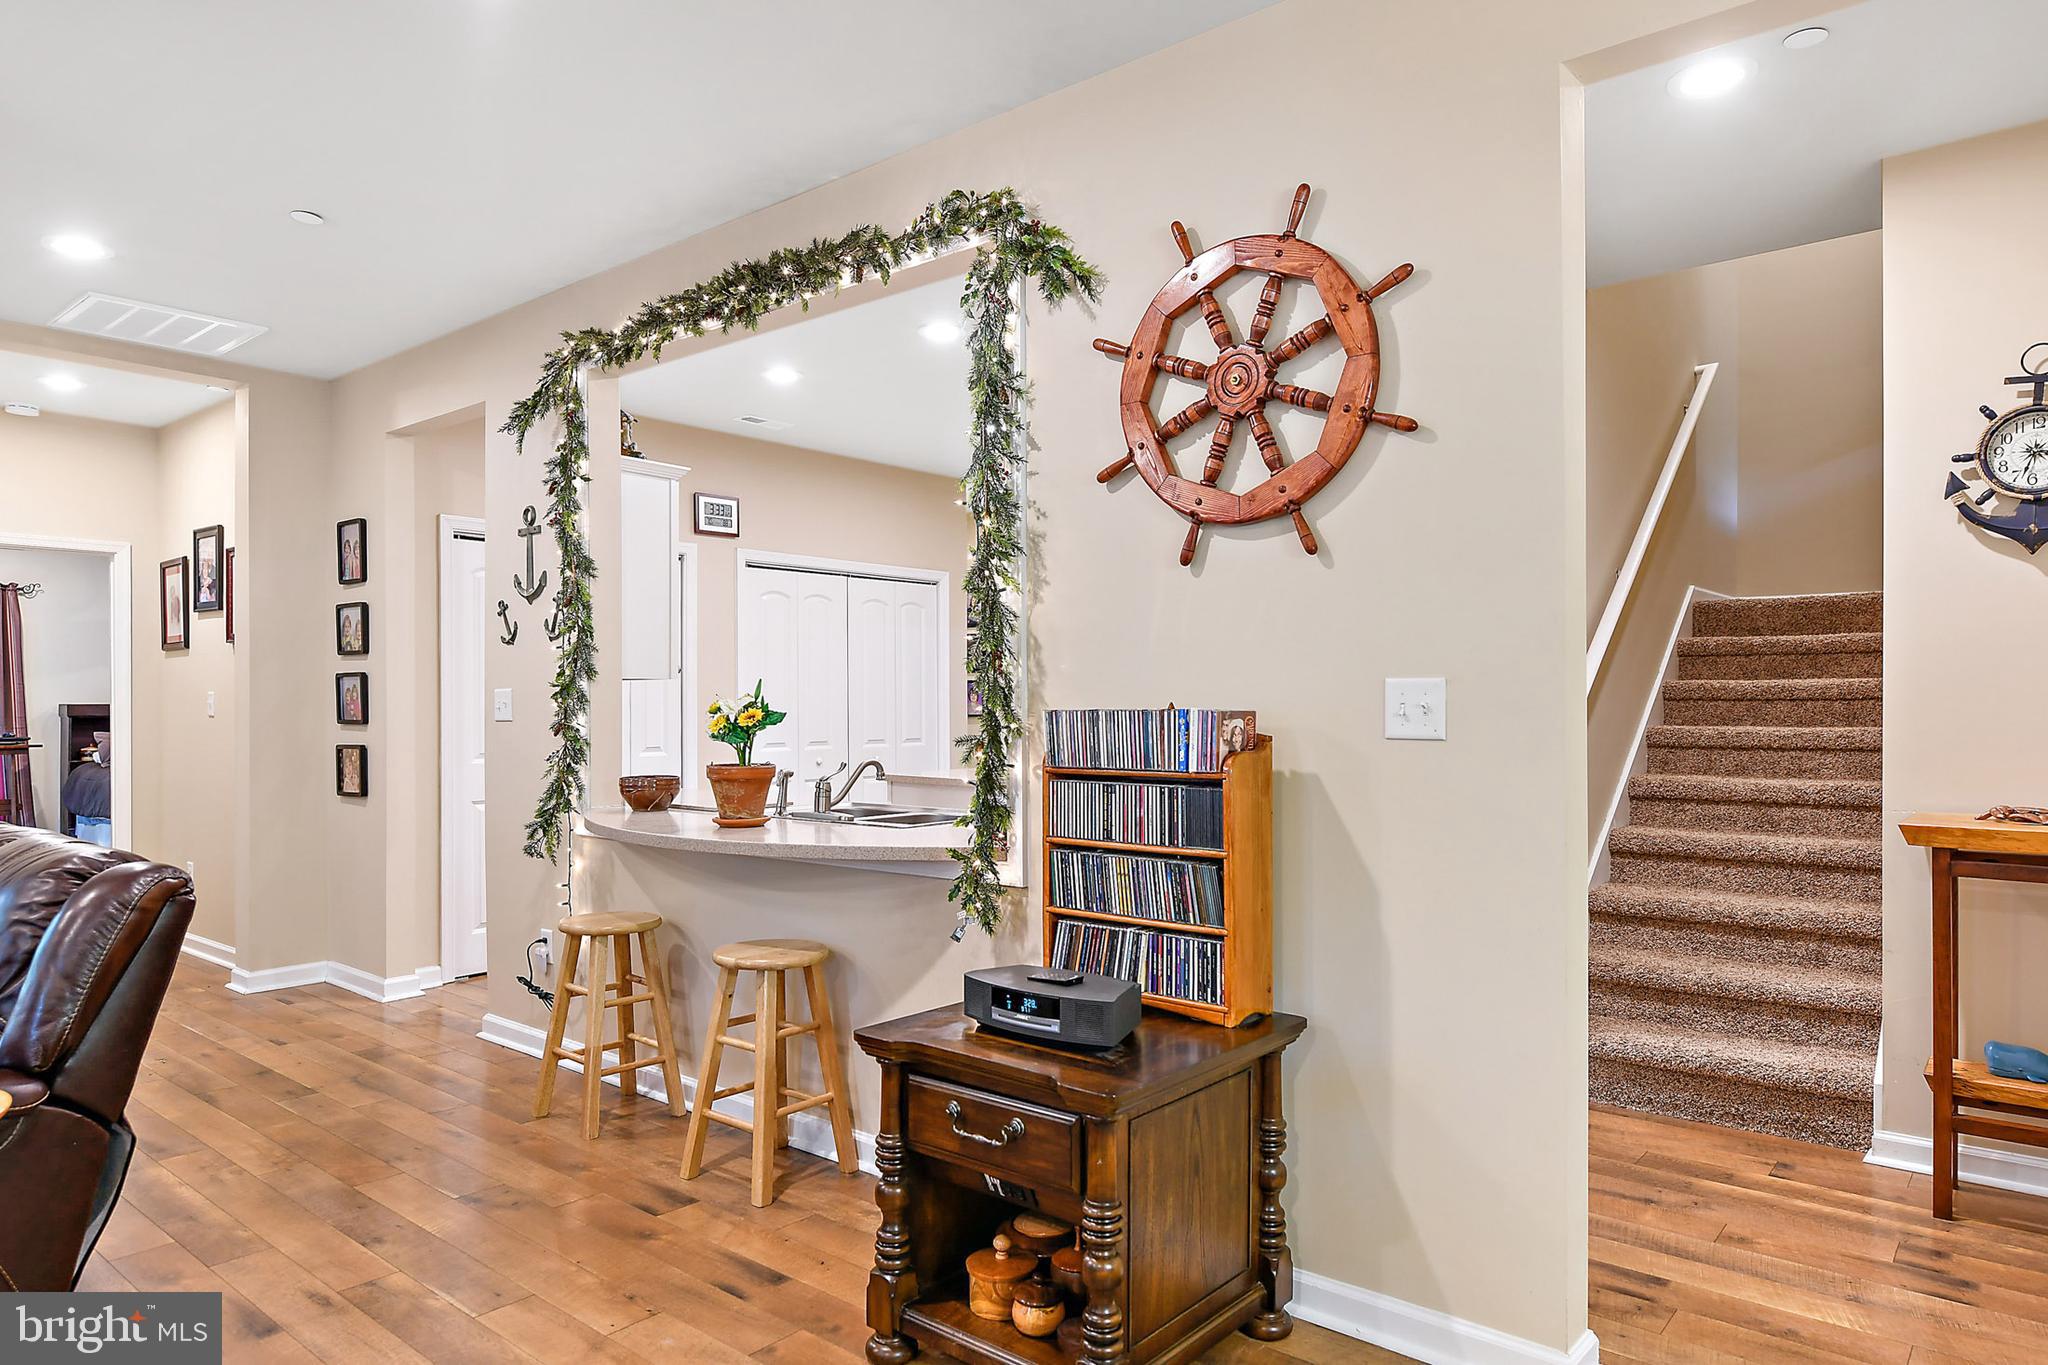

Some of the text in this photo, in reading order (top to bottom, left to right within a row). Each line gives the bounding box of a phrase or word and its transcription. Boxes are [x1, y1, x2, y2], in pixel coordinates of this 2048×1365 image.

[2015, 421, 2025, 434] 11
[2032, 416, 2046, 429] 12
[2000, 432, 2013, 445] 10
[1994, 446, 2005, 458] 9
[1998, 460, 2008, 473] 8
[2012, 470, 2022, 482] 7
[2027, 473, 2038, 486] 6
